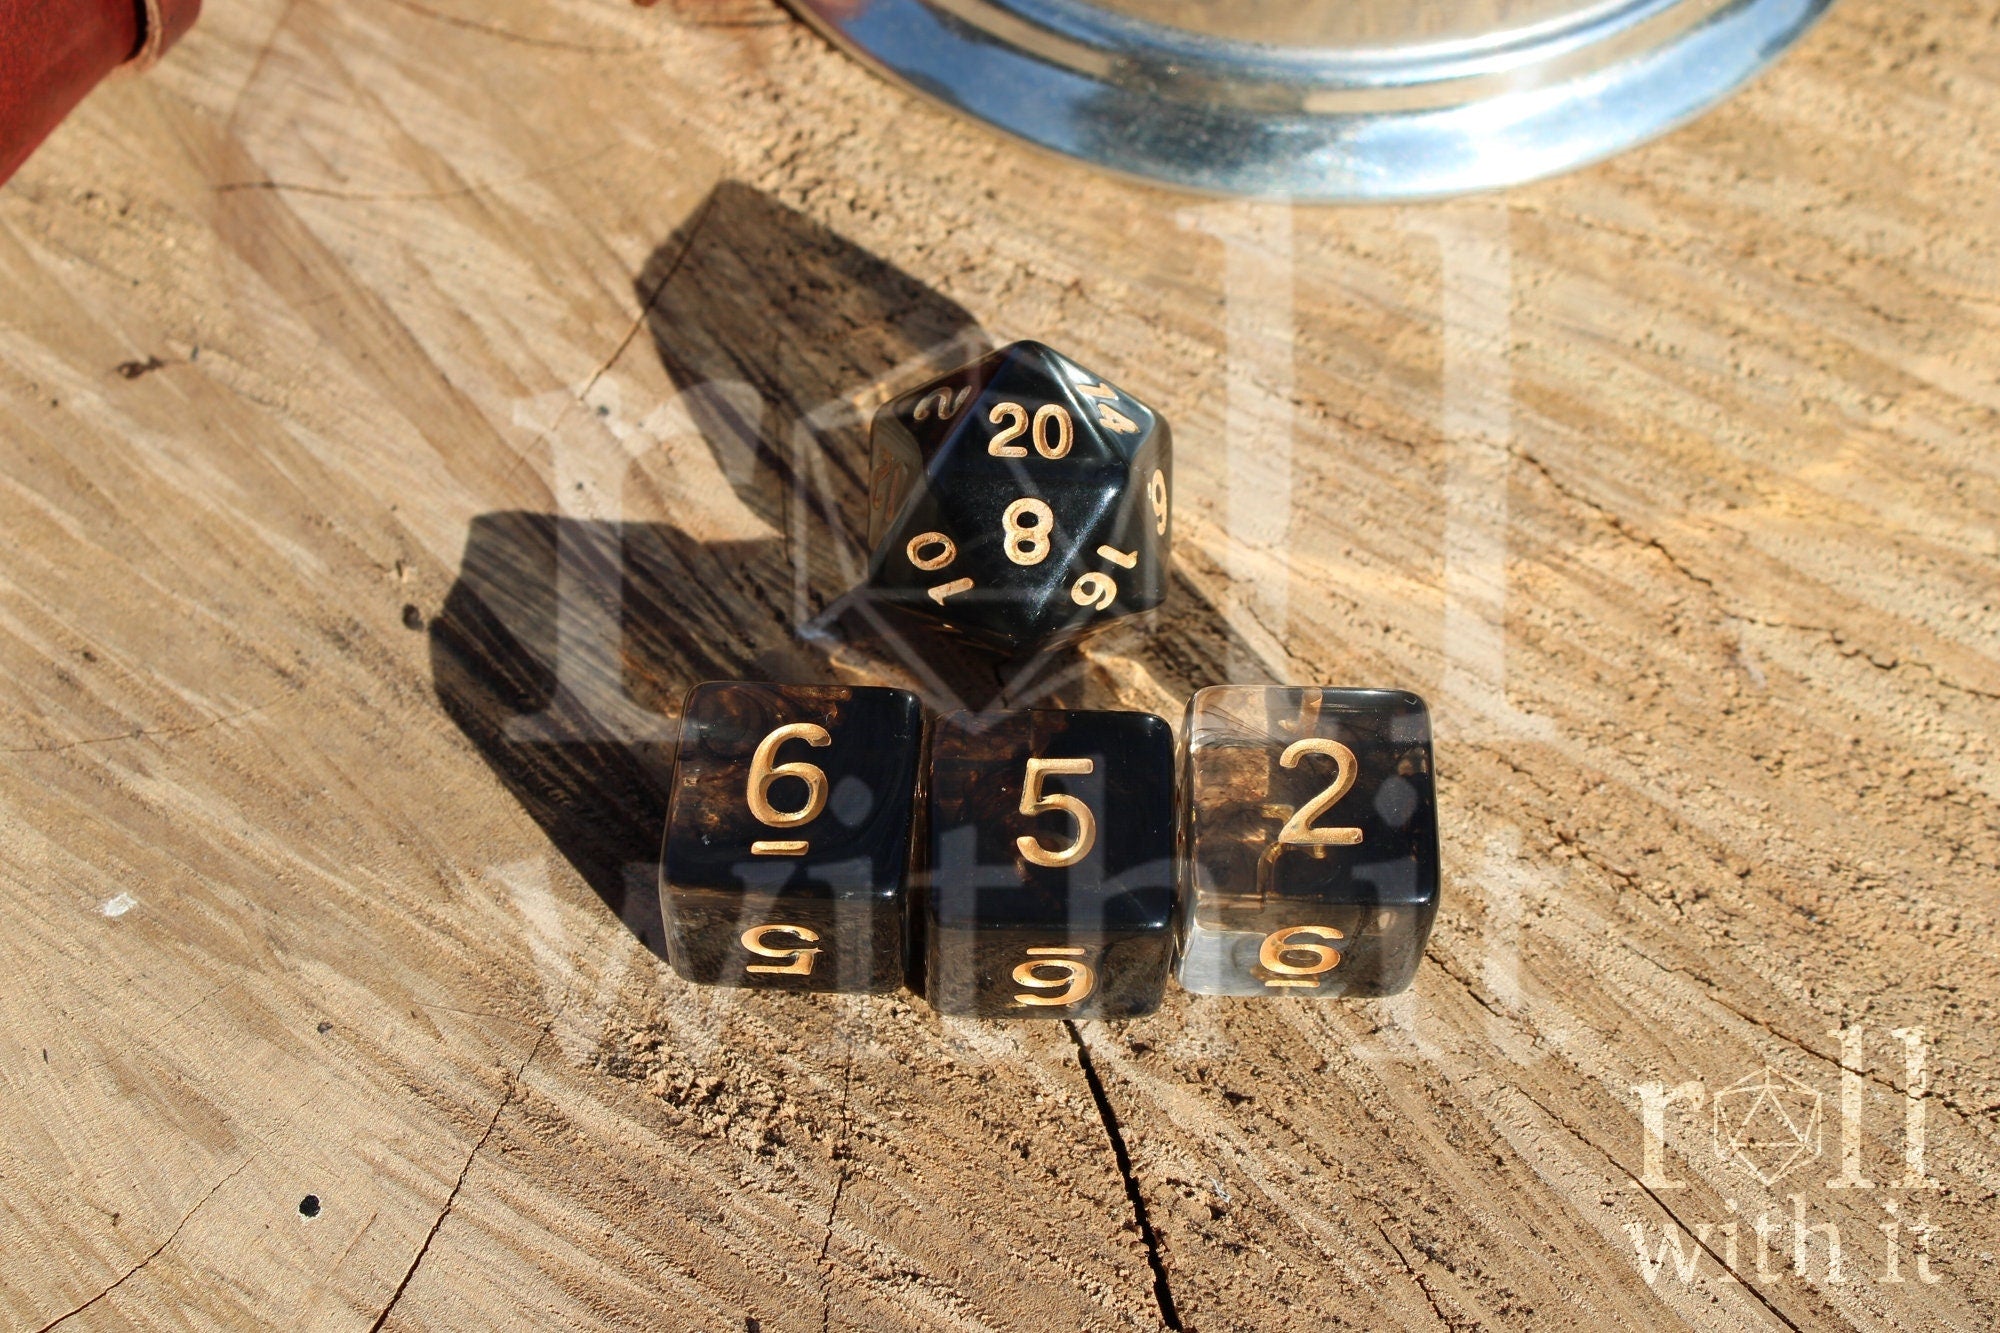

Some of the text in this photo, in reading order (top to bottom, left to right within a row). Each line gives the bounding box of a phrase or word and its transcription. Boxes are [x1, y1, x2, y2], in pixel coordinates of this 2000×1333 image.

[913, 384, 972, 421] 2
[987, 401, 1074, 460] 20
[1075, 382, 1139, 435] 14
[1002, 497, 1054, 566] 8
[906, 531, 975, 607] 10
[1070, 544, 1139, 612] 16
[747, 722, 832, 856] 6
[1016, 758, 1096, 868] 5
[1278, 737, 1364, 846] 2
[740, 924, 823, 976] 5
[1259, 926, 1344, 988] 6
